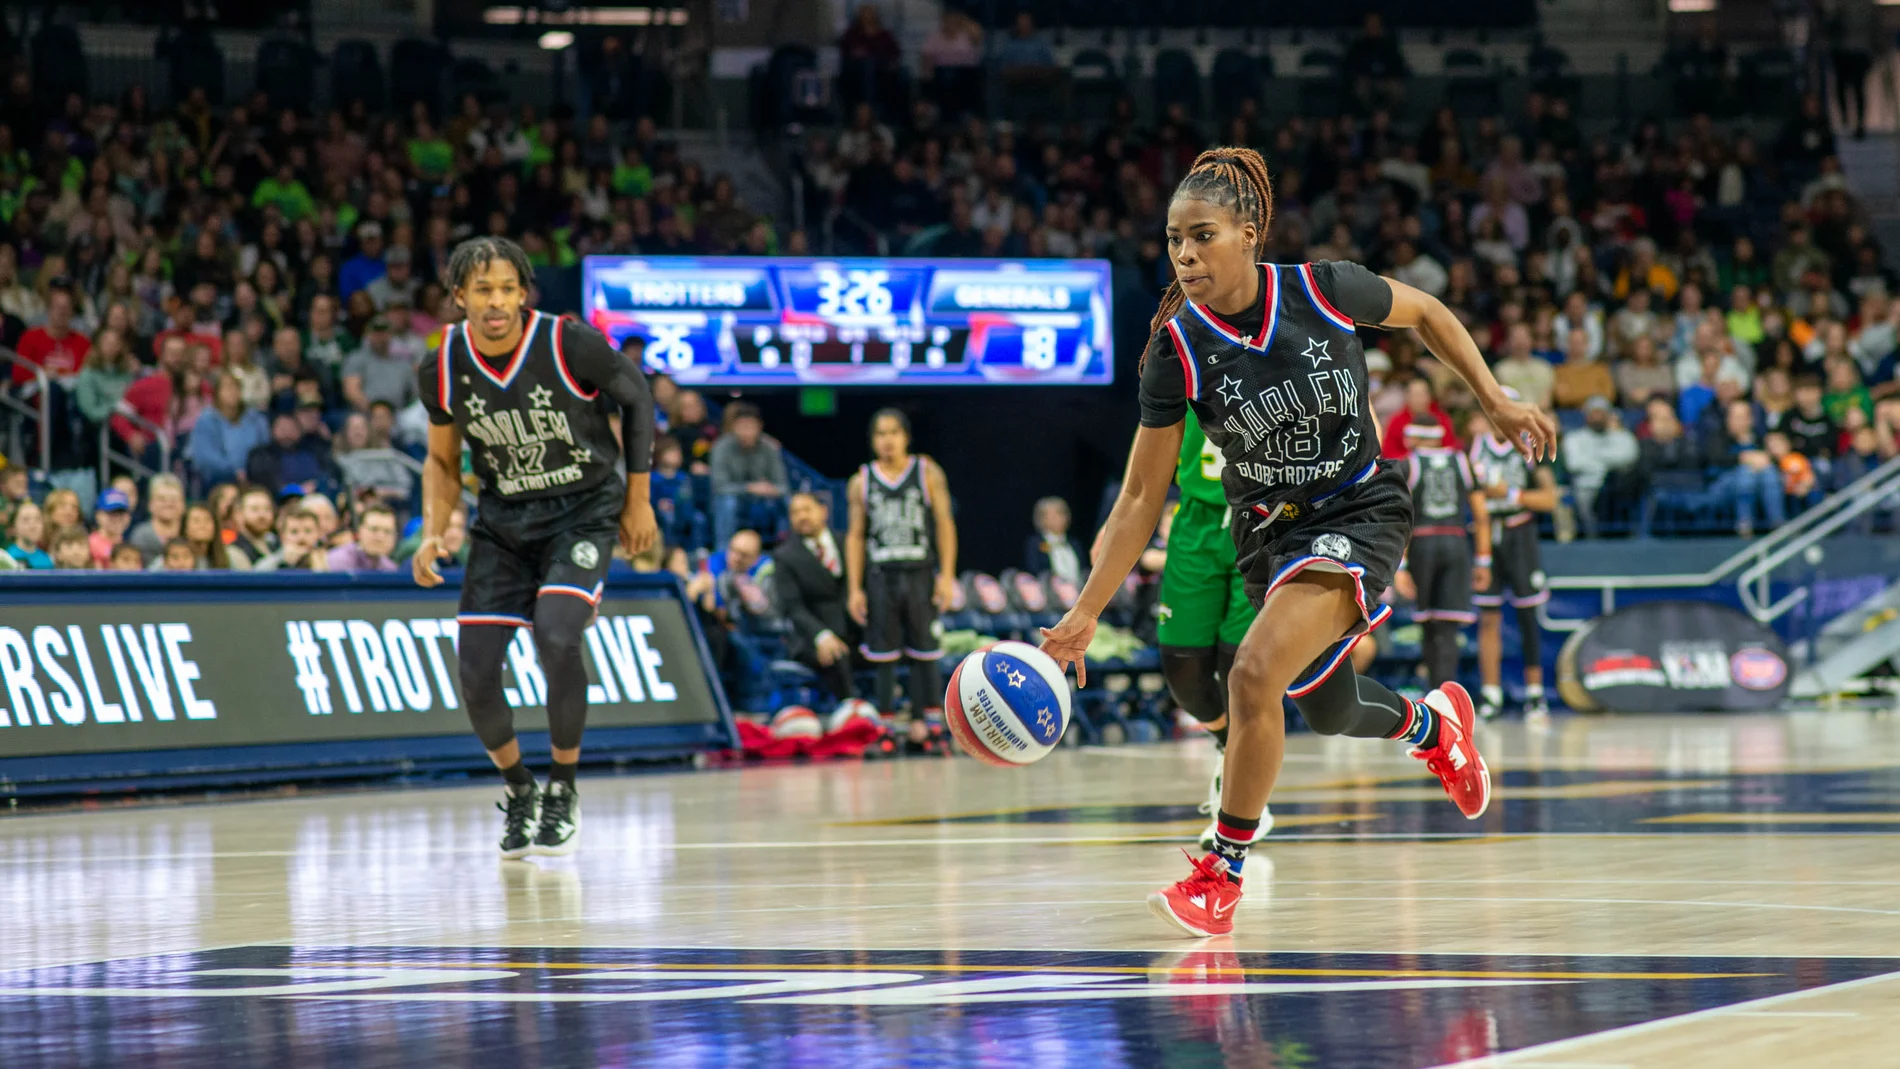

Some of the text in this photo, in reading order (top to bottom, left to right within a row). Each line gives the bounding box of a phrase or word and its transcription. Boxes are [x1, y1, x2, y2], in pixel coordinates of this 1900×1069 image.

[631, 281, 747, 306] TROTTERS
[954, 284, 1071, 309] GENERALS
[644, 325, 694, 370] 26
[466, 409, 575, 447] HARLEM
[1223, 368, 1359, 453] HARLEM
[506, 441, 547, 479] 17
[1264, 415, 1321, 463] 18
[1235, 459, 1345, 487] GLOBETROTERS
[0, 623, 217, 727] RSLIVE
[969, 703, 1010, 752] HARLEM
[976, 688, 1028, 752] GLOBETROTTERS
